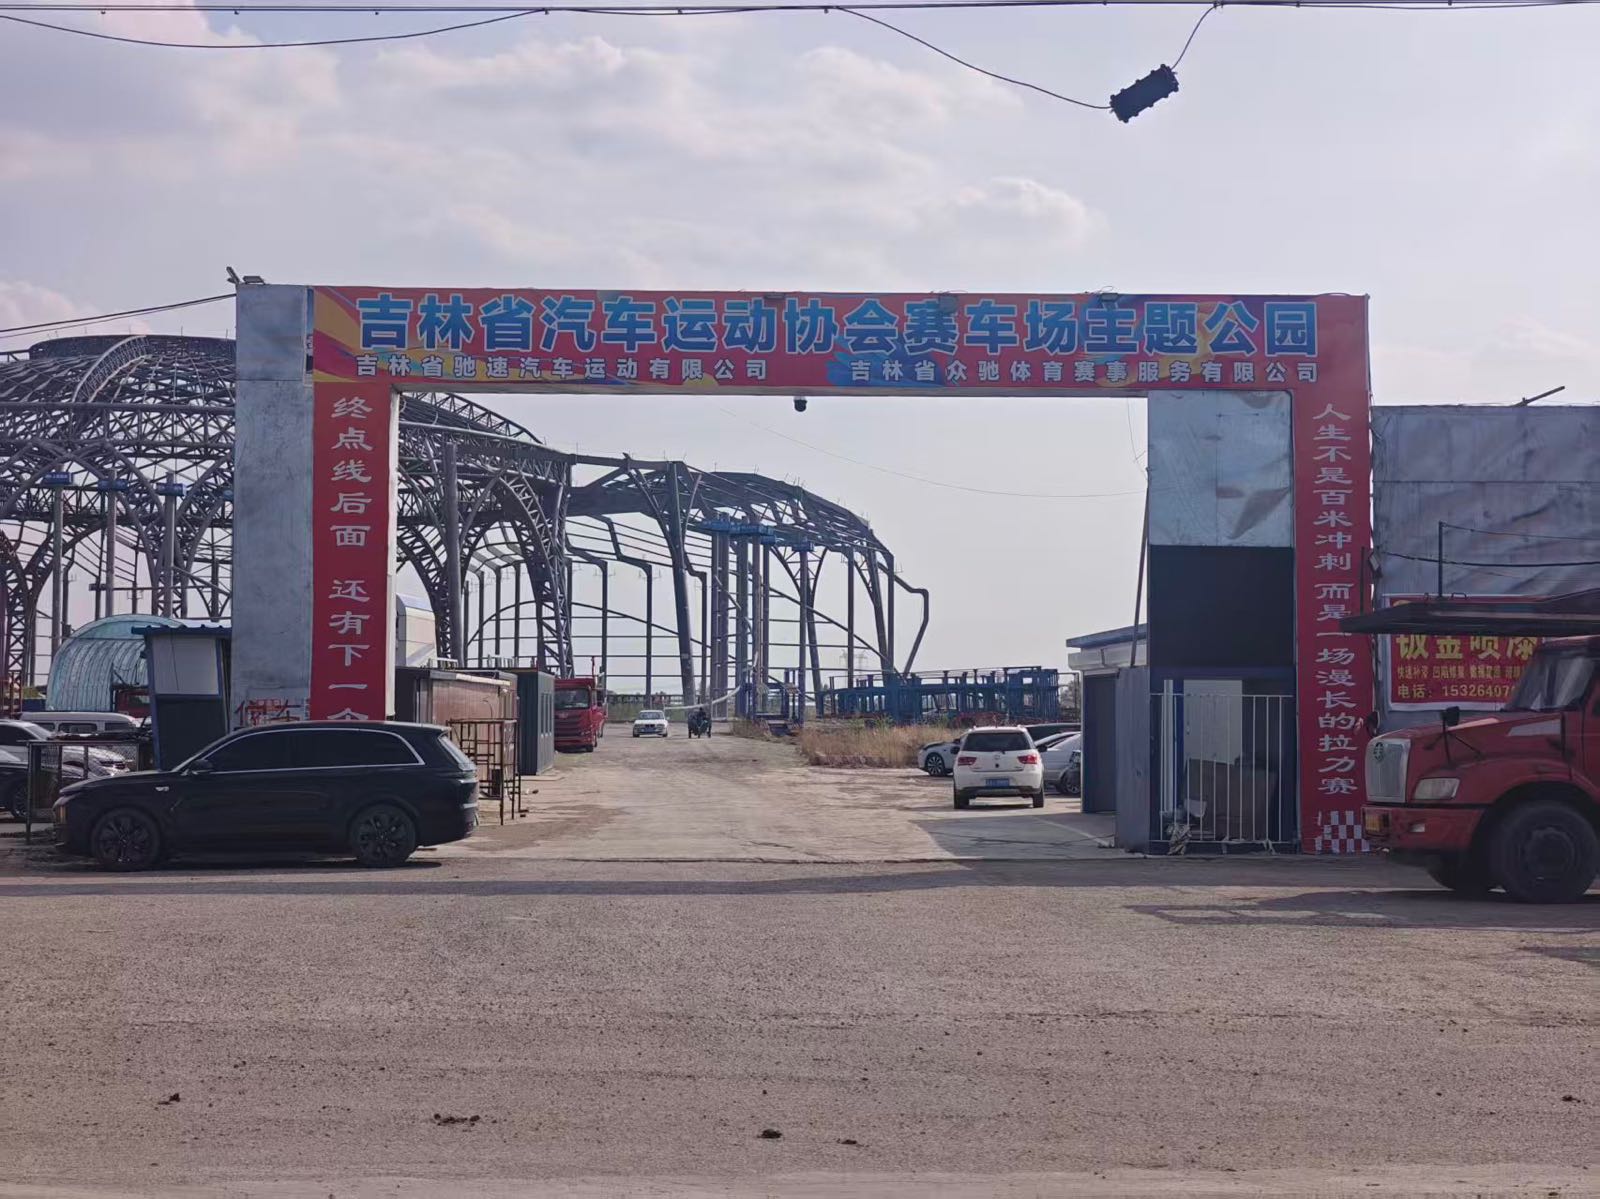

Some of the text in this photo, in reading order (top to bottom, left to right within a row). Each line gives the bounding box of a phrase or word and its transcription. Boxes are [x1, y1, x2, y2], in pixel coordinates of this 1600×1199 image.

[355, 293, 1319, 357] 吉林省汽车运动协会赛车场主题公园
[355, 354, 768, 381] 吉林省驰速汽车运动有限公司
[849, 358, 1319, 384] 吉林省众驰体育赛事服务有限公司
[329, 396, 374, 547] 终点线后面
